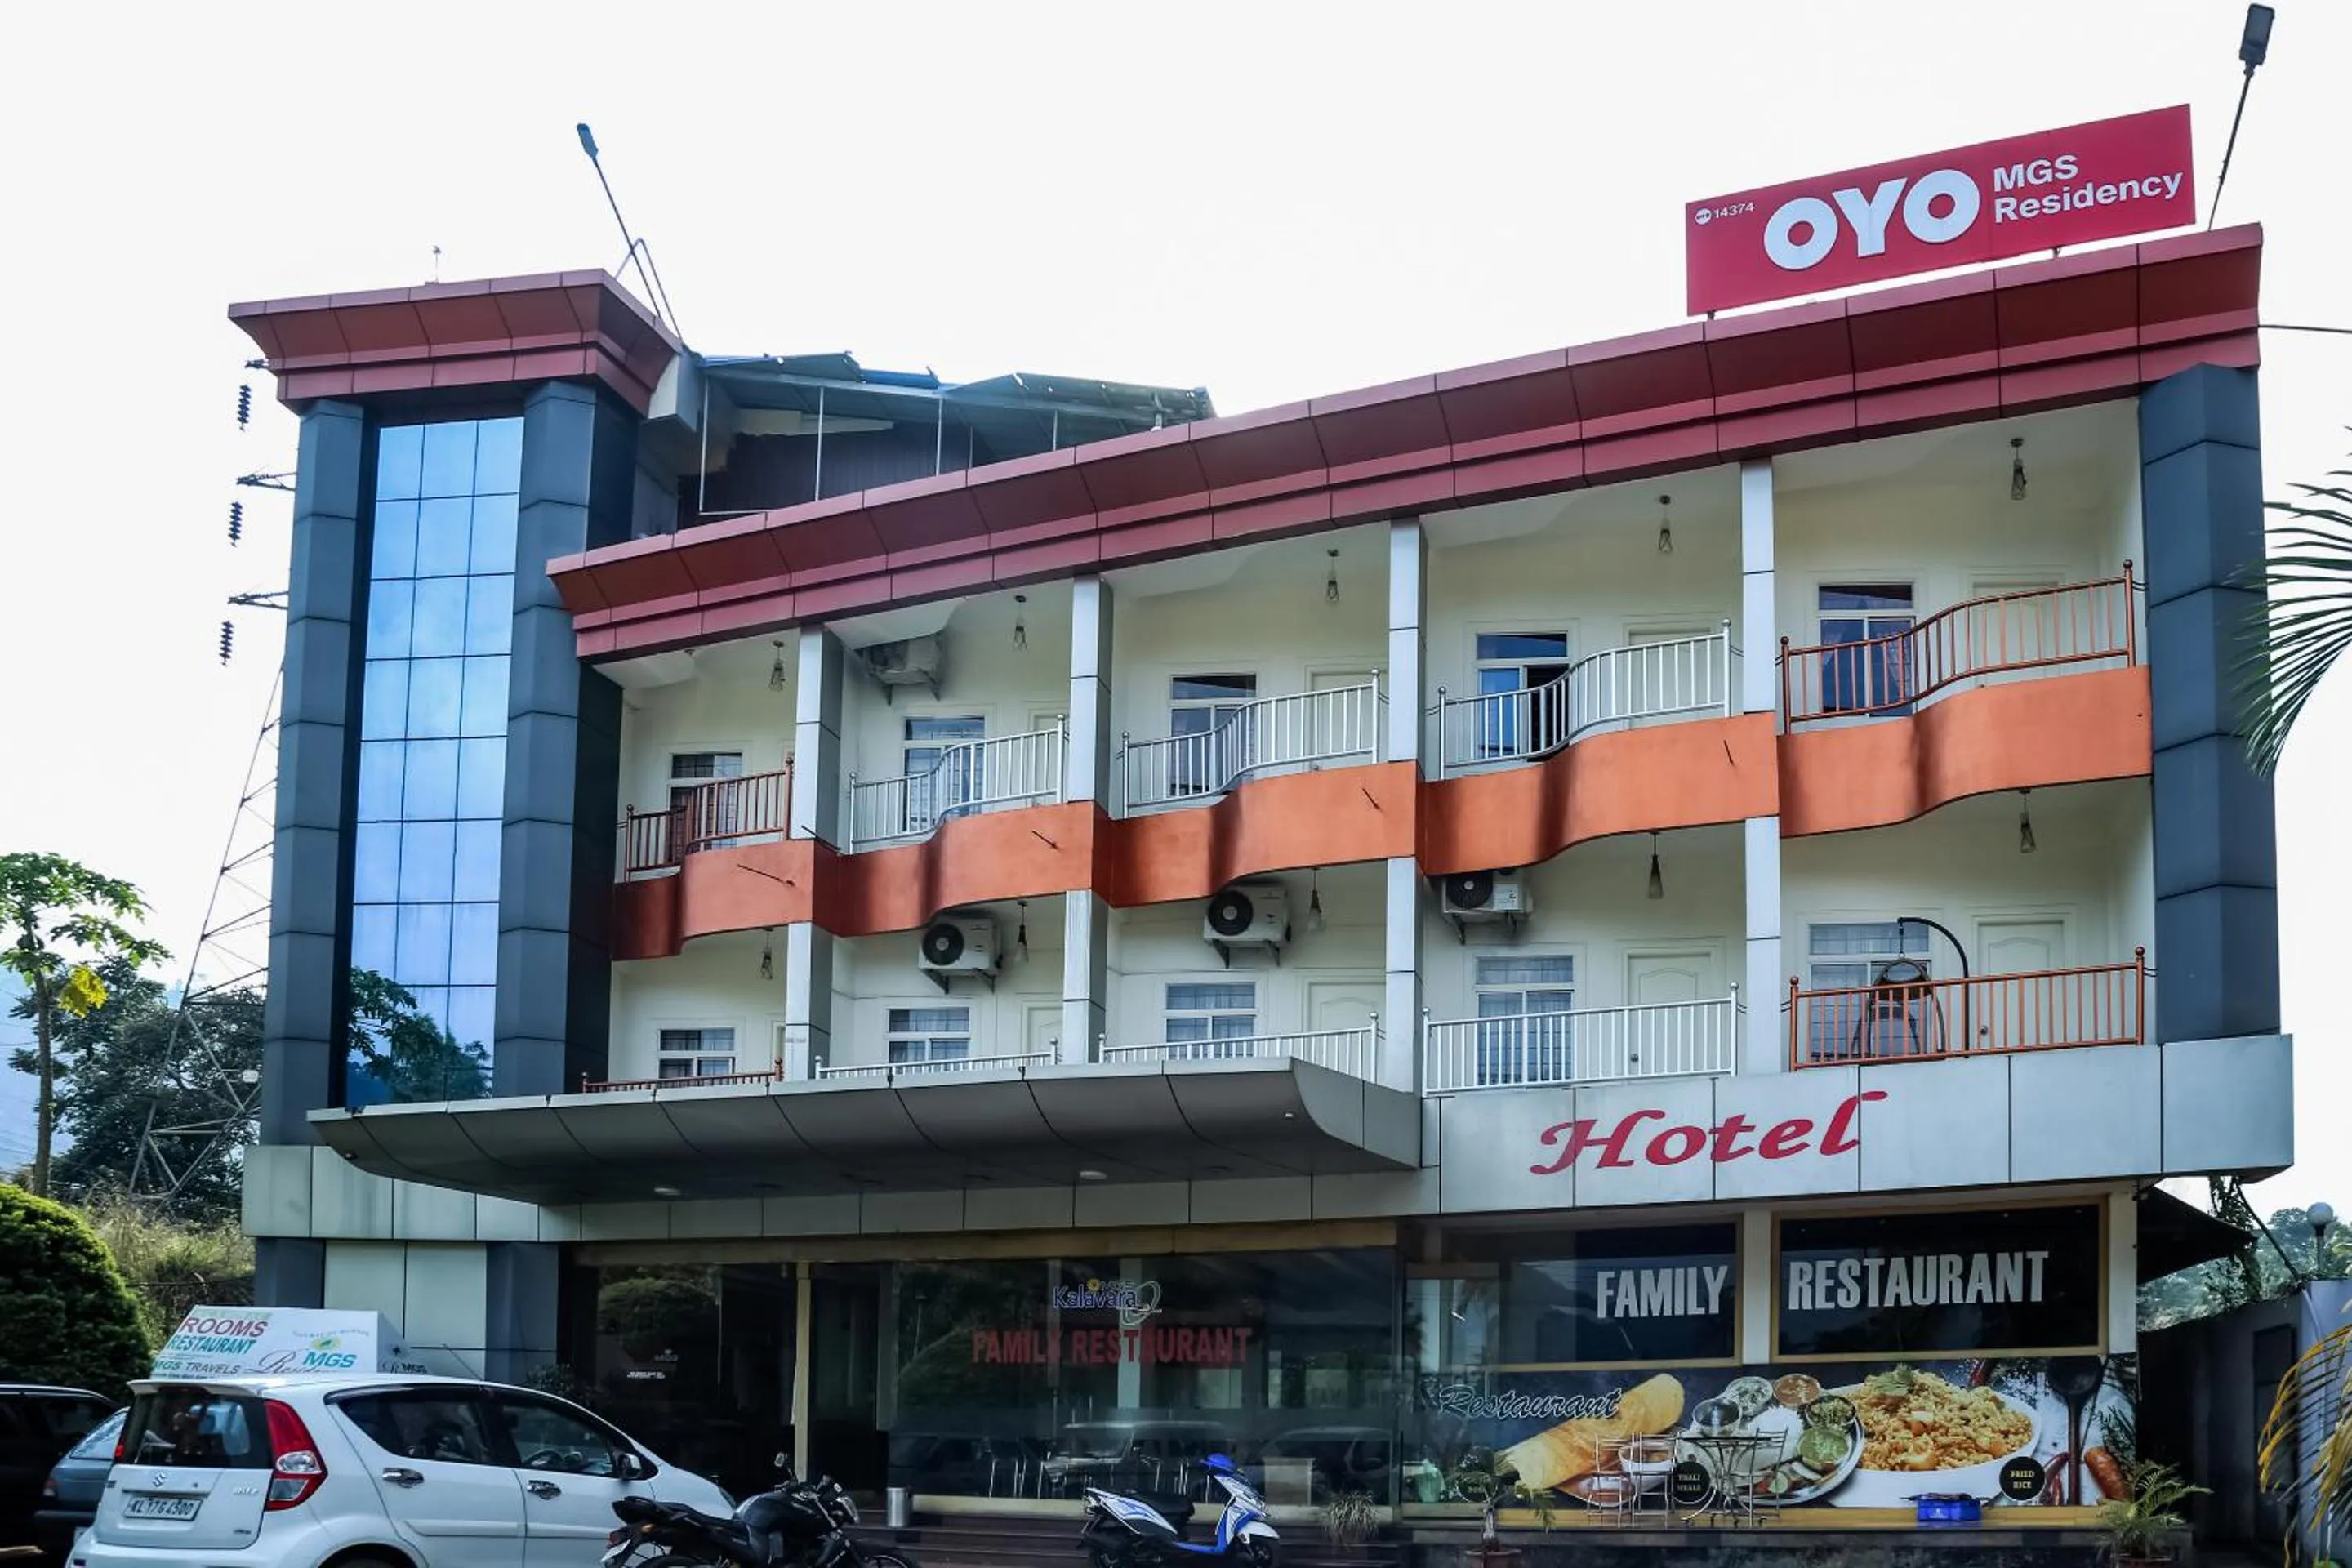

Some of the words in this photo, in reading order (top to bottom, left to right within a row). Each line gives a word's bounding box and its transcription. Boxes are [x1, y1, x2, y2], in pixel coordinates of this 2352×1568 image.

[1994, 155, 2078, 192] MGS
[1715, 202, 1755, 218] 14374
[1994, 172, 2183, 224] Residency
[1763, 168, 1980, 271] OYO
[1529, 1090, 1888, 1176] Hotel
[1053, 1283, 1139, 1309] Kalavara
[1597, 1264, 1729, 1320] FAMILY
[1788, 1250, 2049, 1312] RESTAURANT
[180, 1316, 269, 1338] ROOMS
[167, 1334, 257, 1355] RESTAURANT
[1071, 1326, 1252, 1363] RESTAURANT
[185, 1361, 242, 1374] TRAVELS
[302, 1352, 357, 1369] MGS
[1439, 1384, 1622, 1420] Restaurant
[2011, 1470, 2035, 1478] FRIED
